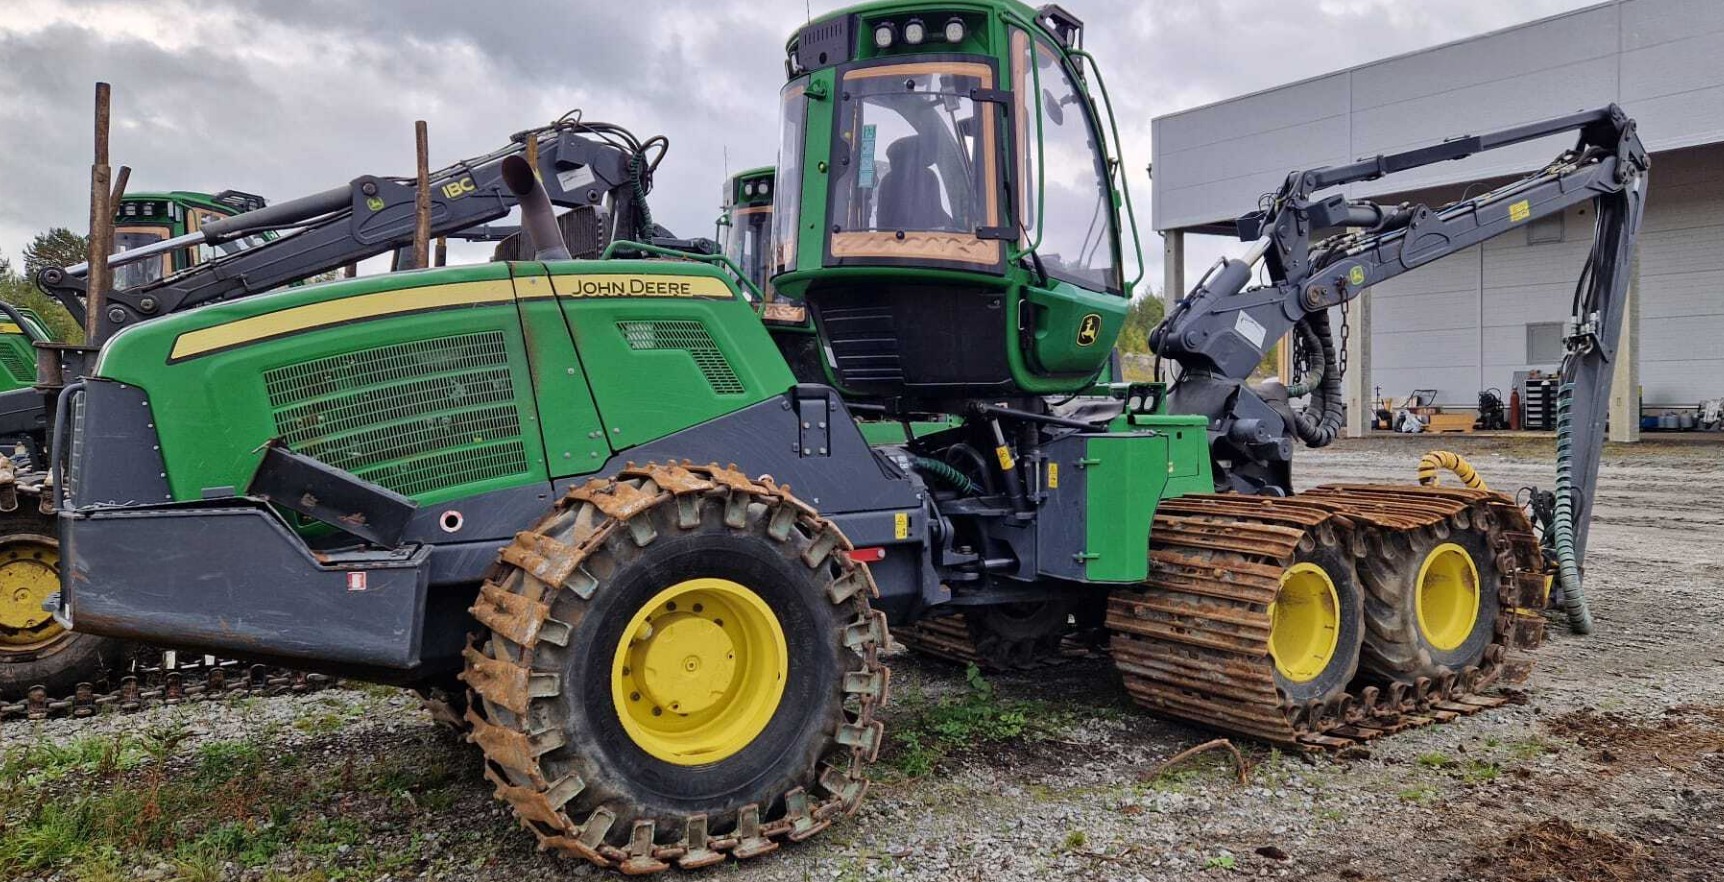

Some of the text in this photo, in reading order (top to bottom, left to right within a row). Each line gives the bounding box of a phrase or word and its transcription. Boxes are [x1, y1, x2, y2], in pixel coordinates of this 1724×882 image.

[441, 177, 476, 199] IBC
[572, 279, 691, 295] JOHN DEERE
